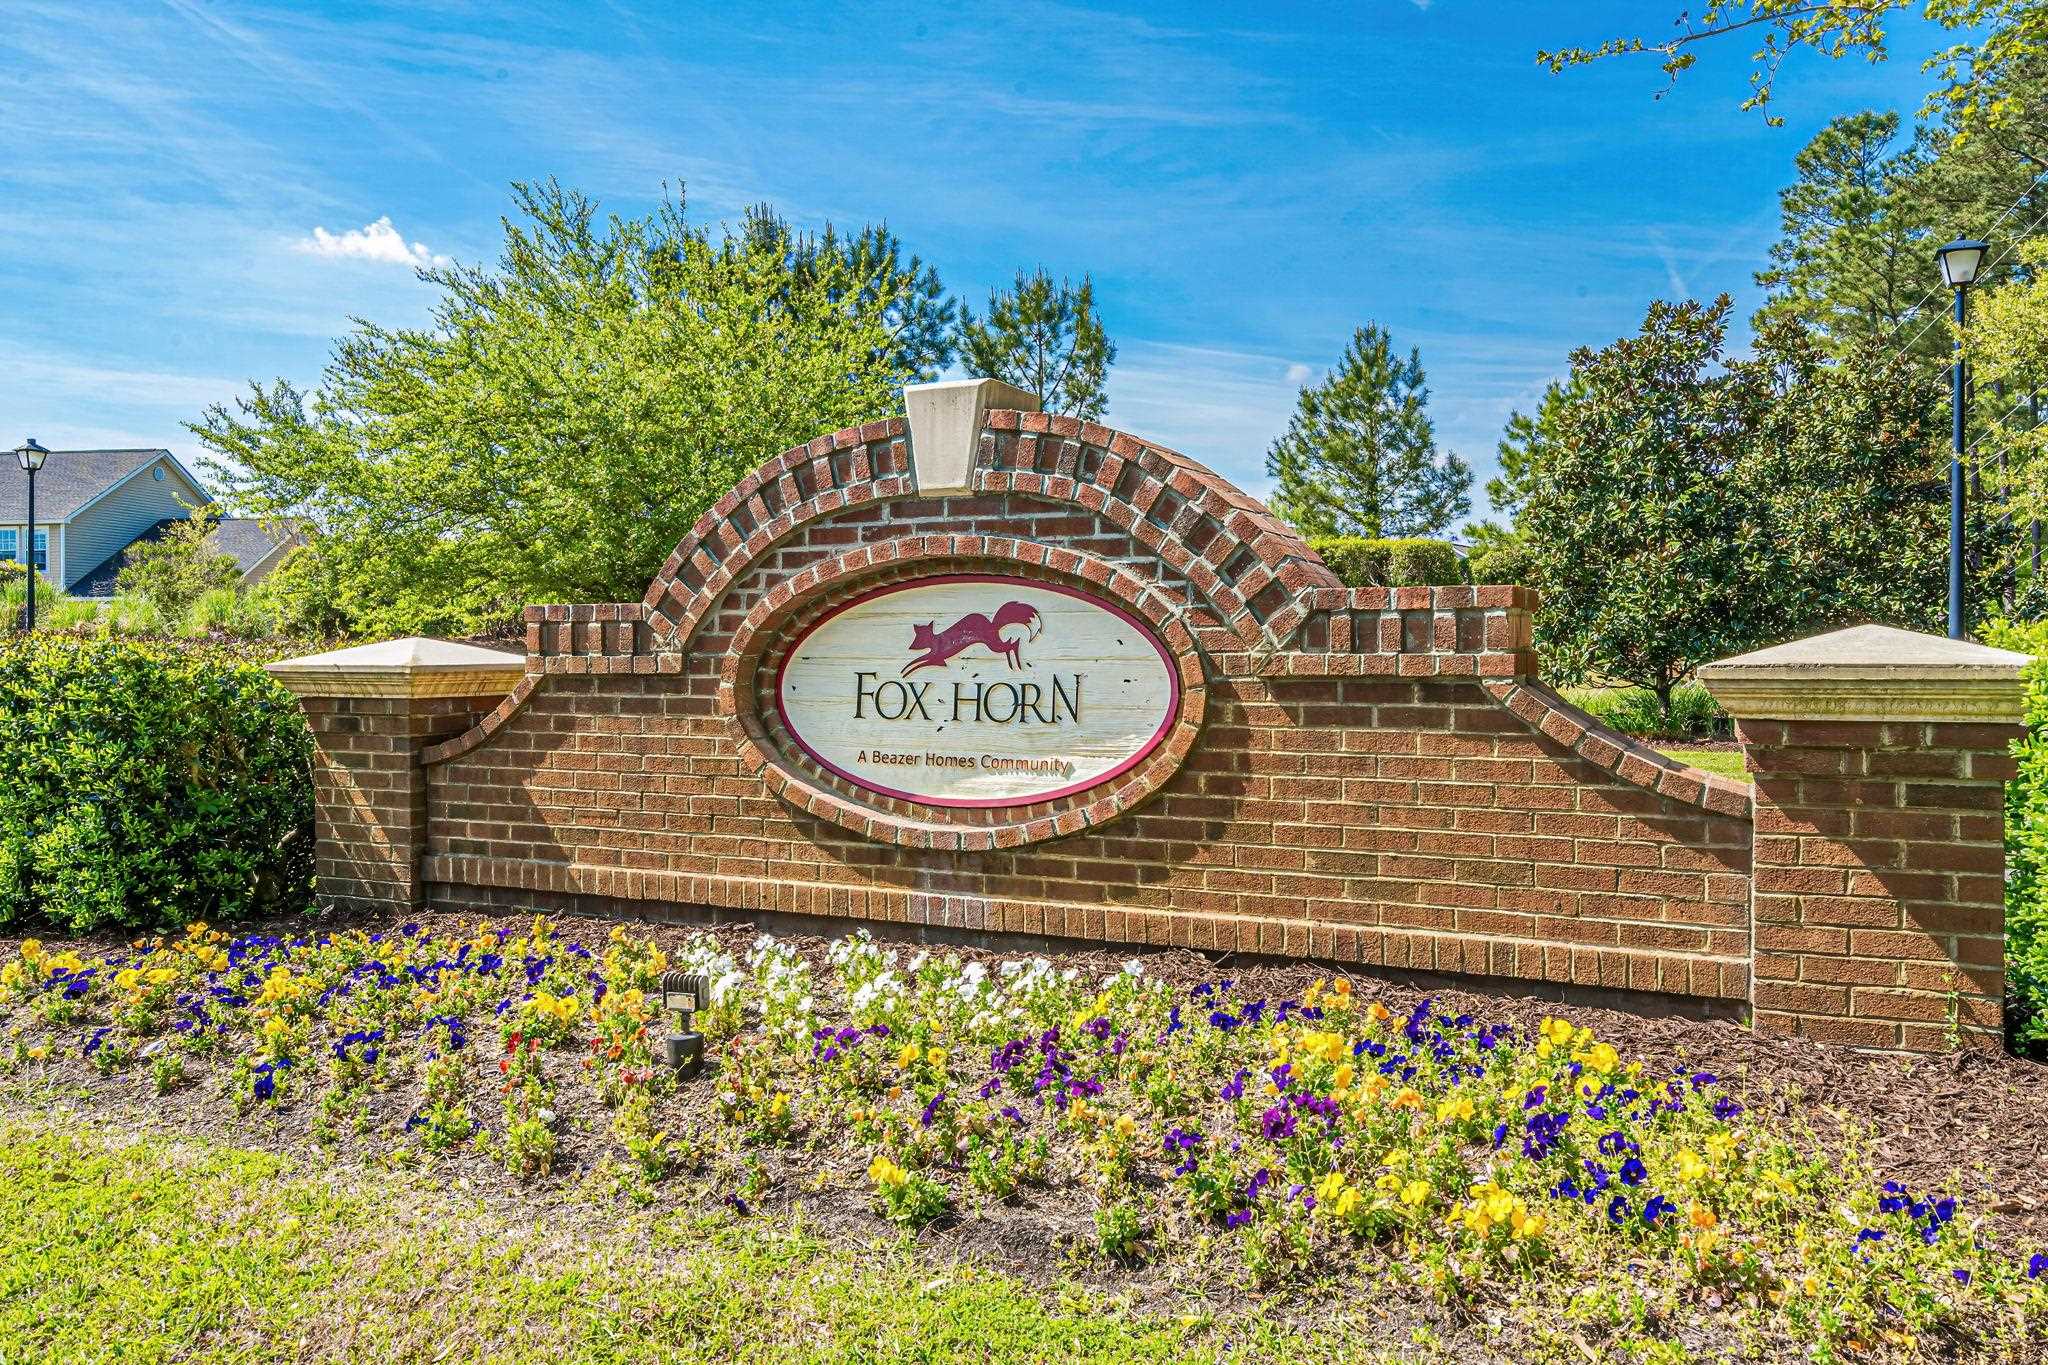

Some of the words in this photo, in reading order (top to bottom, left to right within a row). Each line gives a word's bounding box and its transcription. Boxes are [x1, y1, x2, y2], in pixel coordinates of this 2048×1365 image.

[853, 671, 932, 721] FOX
[950, 673, 1083, 724] HORN
[857, 750, 867, 764] A
[872, 751, 920, 766] Beazer
[925, 752, 975, 768] Homes
[980, 754, 1070, 774] Community
